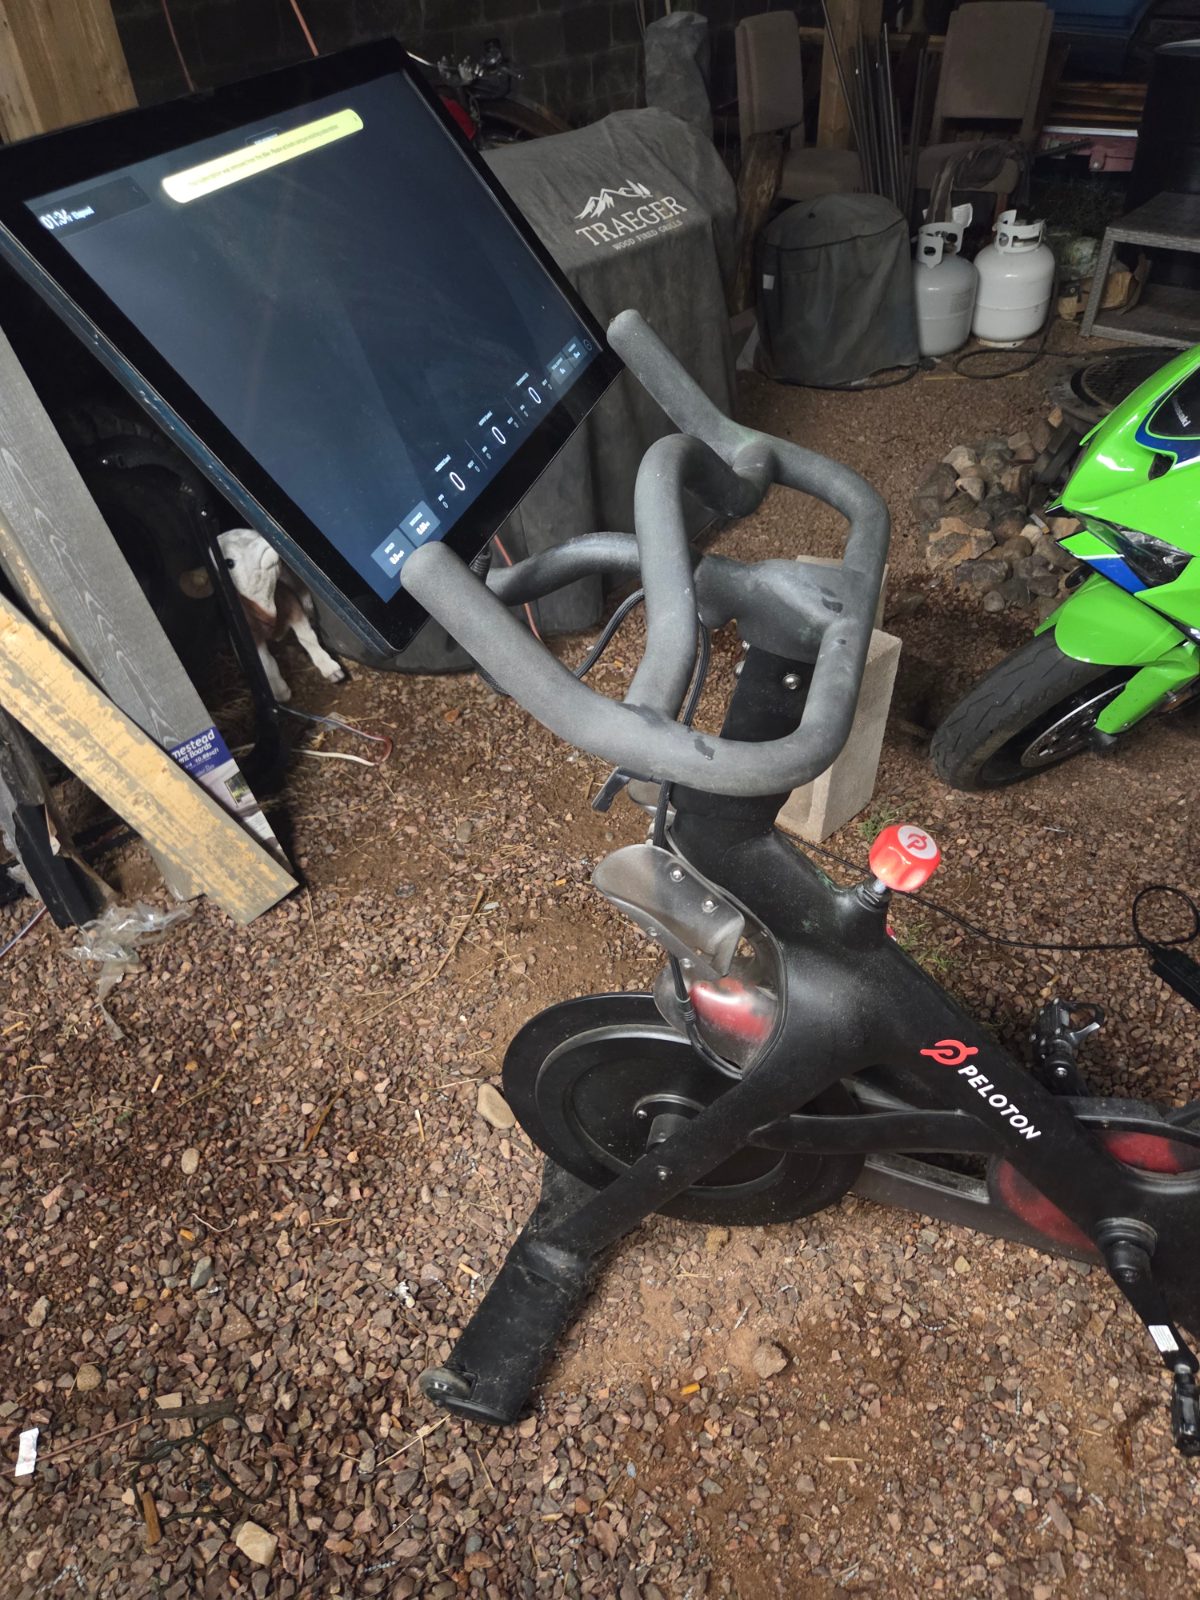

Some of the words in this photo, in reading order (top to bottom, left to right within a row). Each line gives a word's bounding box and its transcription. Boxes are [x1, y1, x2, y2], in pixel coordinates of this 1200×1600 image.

[575, 196, 688, 246] TRAEGER
[612, 238, 636, 250] WOOD
[635, 229, 658, 242] FIRED
[658, 219, 683, 234] GRILLS
[528, 386, 542, 404] 0
[491, 426, 506, 445] 0
[449, 472, 466, 491] 0
[957, 1065, 1042, 1140] PELOTON
